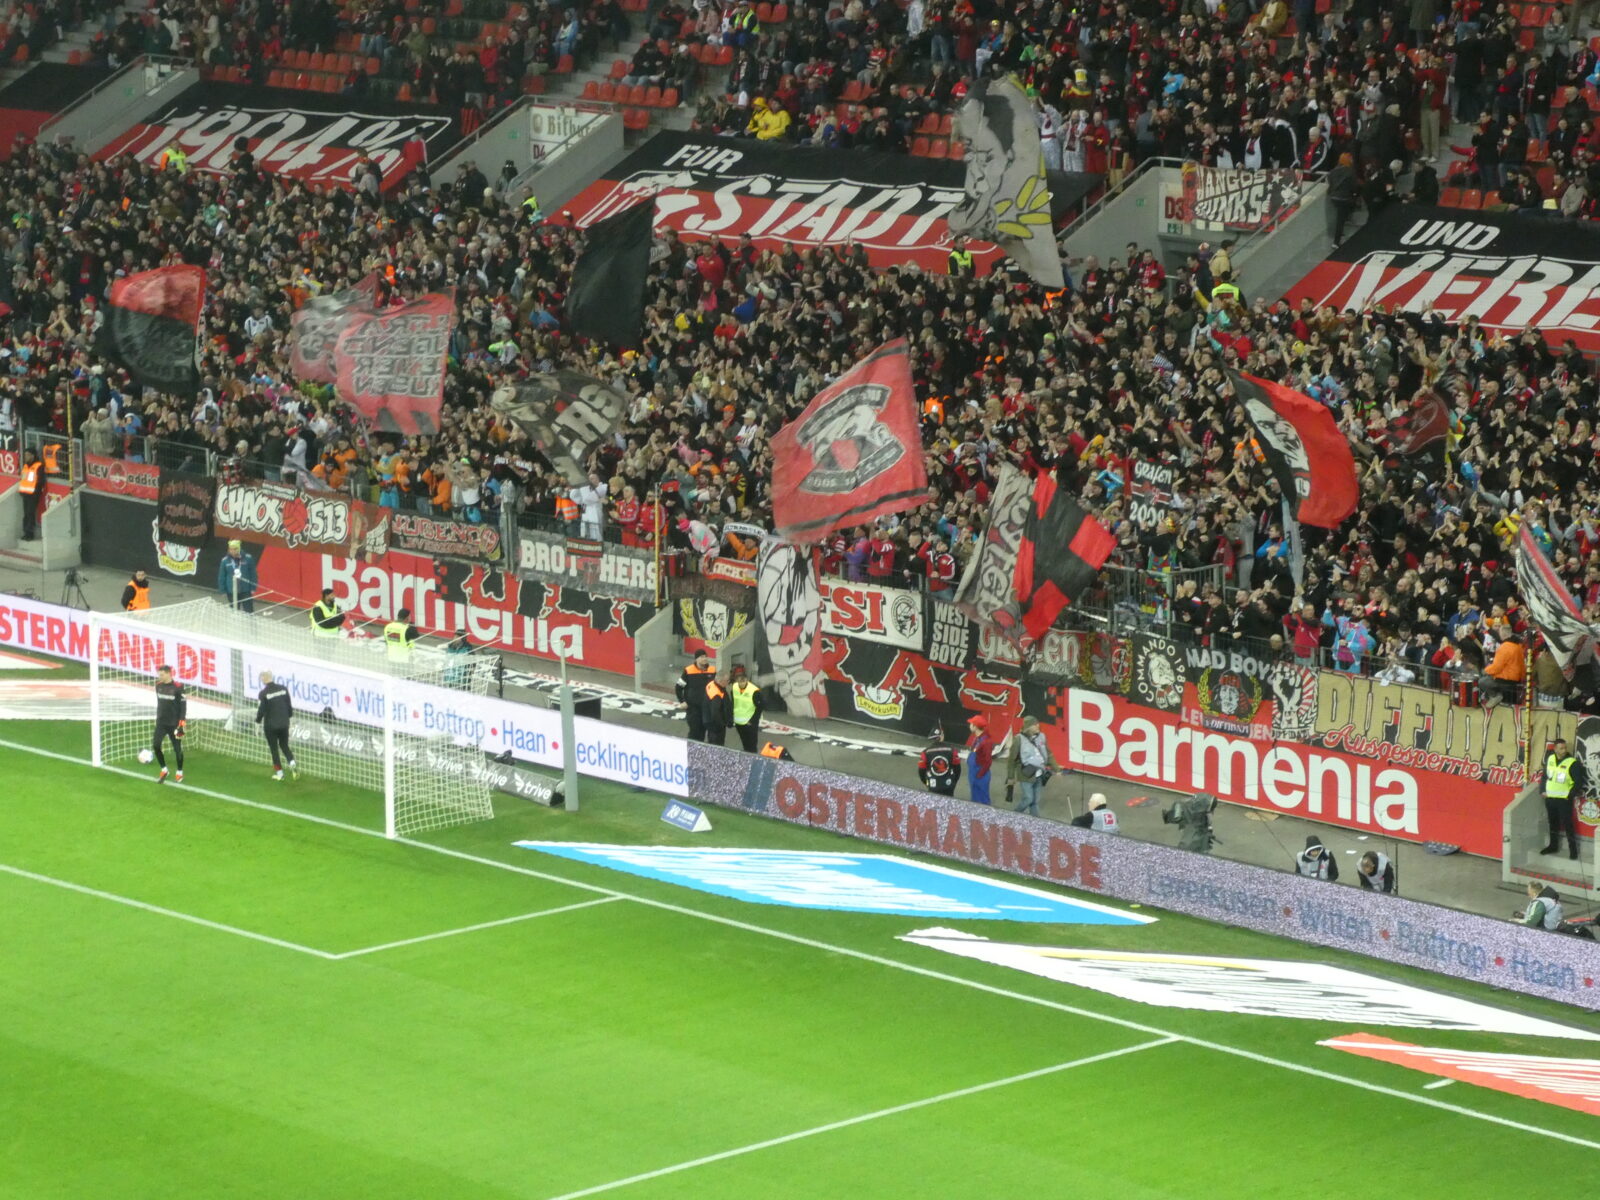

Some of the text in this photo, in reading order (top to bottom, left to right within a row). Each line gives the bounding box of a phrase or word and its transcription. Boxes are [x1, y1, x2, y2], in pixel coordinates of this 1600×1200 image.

[663, 144, 743, 173] FÜR
[683, 176, 965, 245] STADT
[1400, 219, 1500, 250] UND
[88, 462, 108, 479] LEV
[933, 602, 970, 629] WEST
[932, 620, 970, 643] SIDE
[928, 641, 969, 668] BOYZ
[1186, 647, 1226, 671] MAD
[859, 696, 899, 714] Leverkusen
[424, 702, 485, 745] Bottrop
[502, 719, 546, 754] Haan
[1068, 687, 1420, 835] Barmenia
[481, 770, 508, 787] trive
[524, 781, 551, 800] trive
[775, 776, 1103, 889] OSTERMANN.DE
[1512, 946, 1576, 991] Haan
